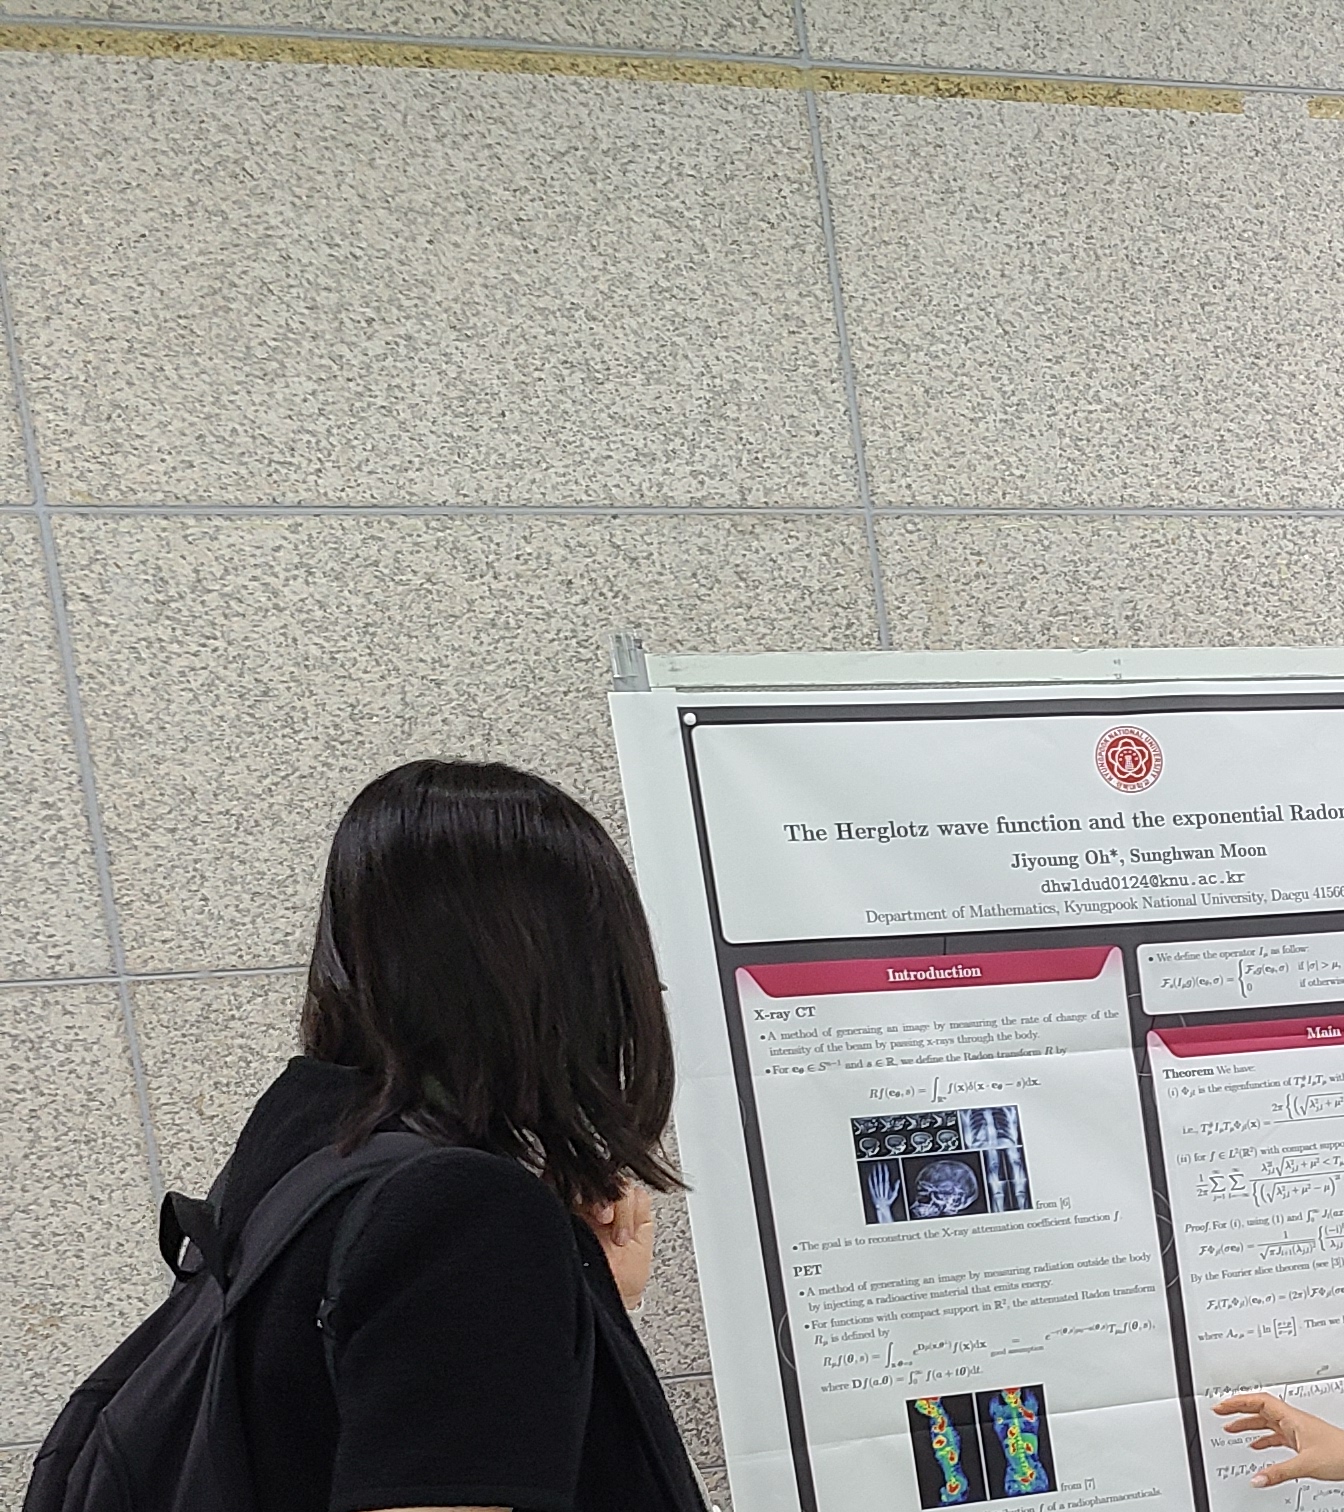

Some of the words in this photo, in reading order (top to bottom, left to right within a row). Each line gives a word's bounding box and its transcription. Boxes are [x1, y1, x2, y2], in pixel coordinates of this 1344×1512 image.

[785, 823, 828, 842] The
[835, 820, 929, 844] Herglotz
[937, 821, 989, 836] wave
[996, 813, 1081, 834] function
[1088, 811, 1124, 830] and
[1131, 810, 1165, 829] the
[1171, 804, 1283, 830] exponential
[1010, 852, 1079, 872] Jiyoung
[1129, 845, 1215, 865] Sunghwan
[1219, 842, 1267, 859] Moon
[1040, 870, 1246, 894] dhwldud0124@knu.ac.kr
[865, 907, 948, 926] Department
[951, 904, 965, 919] of
[968, 901, 1060, 919] Mathematics,
[1063, 896, 1139, 916] Kyungpook
[1141, 892, 1197, 910] National
[1200, 890, 1268, 906] University,
[1270, 888, 1310, 904] Daegu
[1155, 952, 1173, 963] We
[1172, 950, 1201, 962] define
[1201, 949, 1218, 960] the
[1218, 948, 1256, 960] operator
[886, 964, 982, 982] Introduction
[753, 1008, 790, 1022] X-ray
[794, 1005, 816, 1018] CT
[767, 1030, 777, 1041] A
[779, 1027, 819, 1040] method
[821, 1026, 832, 1038] of
[885, 1025, 899, 1033] an
[901, 1022, 931, 1033] image
[932, 1020, 946, 1032] by
[948, 1017, 998, 1030] measuring
[1000, 1015, 1017, 1026] the
[1019, 1015, 1040, 1025] rate
[1041, 1012, 1053, 1023] of
[1054, 1011, 1088, 1023] change
[1090, 1009, 1101, 1020] of
[1103, 1008, 1120, 1019] the
[768, 1044, 812, 1057] intensity
[813, 1042, 825, 1054] of
[826, 1041, 844, 1053] the
[844, 1040, 873, 1051] beam
[873, 1038, 888, 1051] by
[888, 1037, 925, 1051] passing
[925, 1037, 955, 1047] x-rays
[956, 1031, 995, 1045] through
[995, 1031, 1013, 1042] the
[1013, 1028, 1040, 1042] body.
[1306, 1025, 1342, 1040] Main
[1161, 1067, 1215, 1080] Theorem
[796, 1240, 820, 1252] The
[821, 1237, 842, 1251] goal
[843, 1237, 853, 1247] is
[854, 1237, 866, 1246] to
[867, 1231, 922, 1245] reconstruct
[922, 1228, 940, 1239] the
[940, 1226, 969, 1238] X-ray
[970, 1221, 1025, 1235] attenuation
[1026, 1216, 1072, 1229] coefficient
[792, 1263, 823, 1278] PET
[806, 1286, 816, 1298] A
[817, 1281, 855, 1296] method
[856, 1280, 868, 1291] of
[869, 1276, 921, 1292] generating
[922, 1276, 936, 1285] an
[937, 1273, 967, 1284] image
[967, 1269, 981, 1282] by
[982, 1265, 1032, 1279] measuring
[1032, 1260, 1075, 1274] radiation
[1076, 1255, 1110, 1268] outside
[1110, 1254, 1127, 1265] the
[1128, 1251, 1152, 1263] body
[807, 1301, 821, 1314] by
[822, 1297, 866, 1312] injecting
[866, 1298, 874, 1306] a
[874, 1290, 928, 1305] radioactive
[929, 1284, 969, 1299] material
[970, 1283, 992, 1295] that
[992, 1281, 1020, 1292] emits
[1020, 1278, 1054, 1289] energy.
